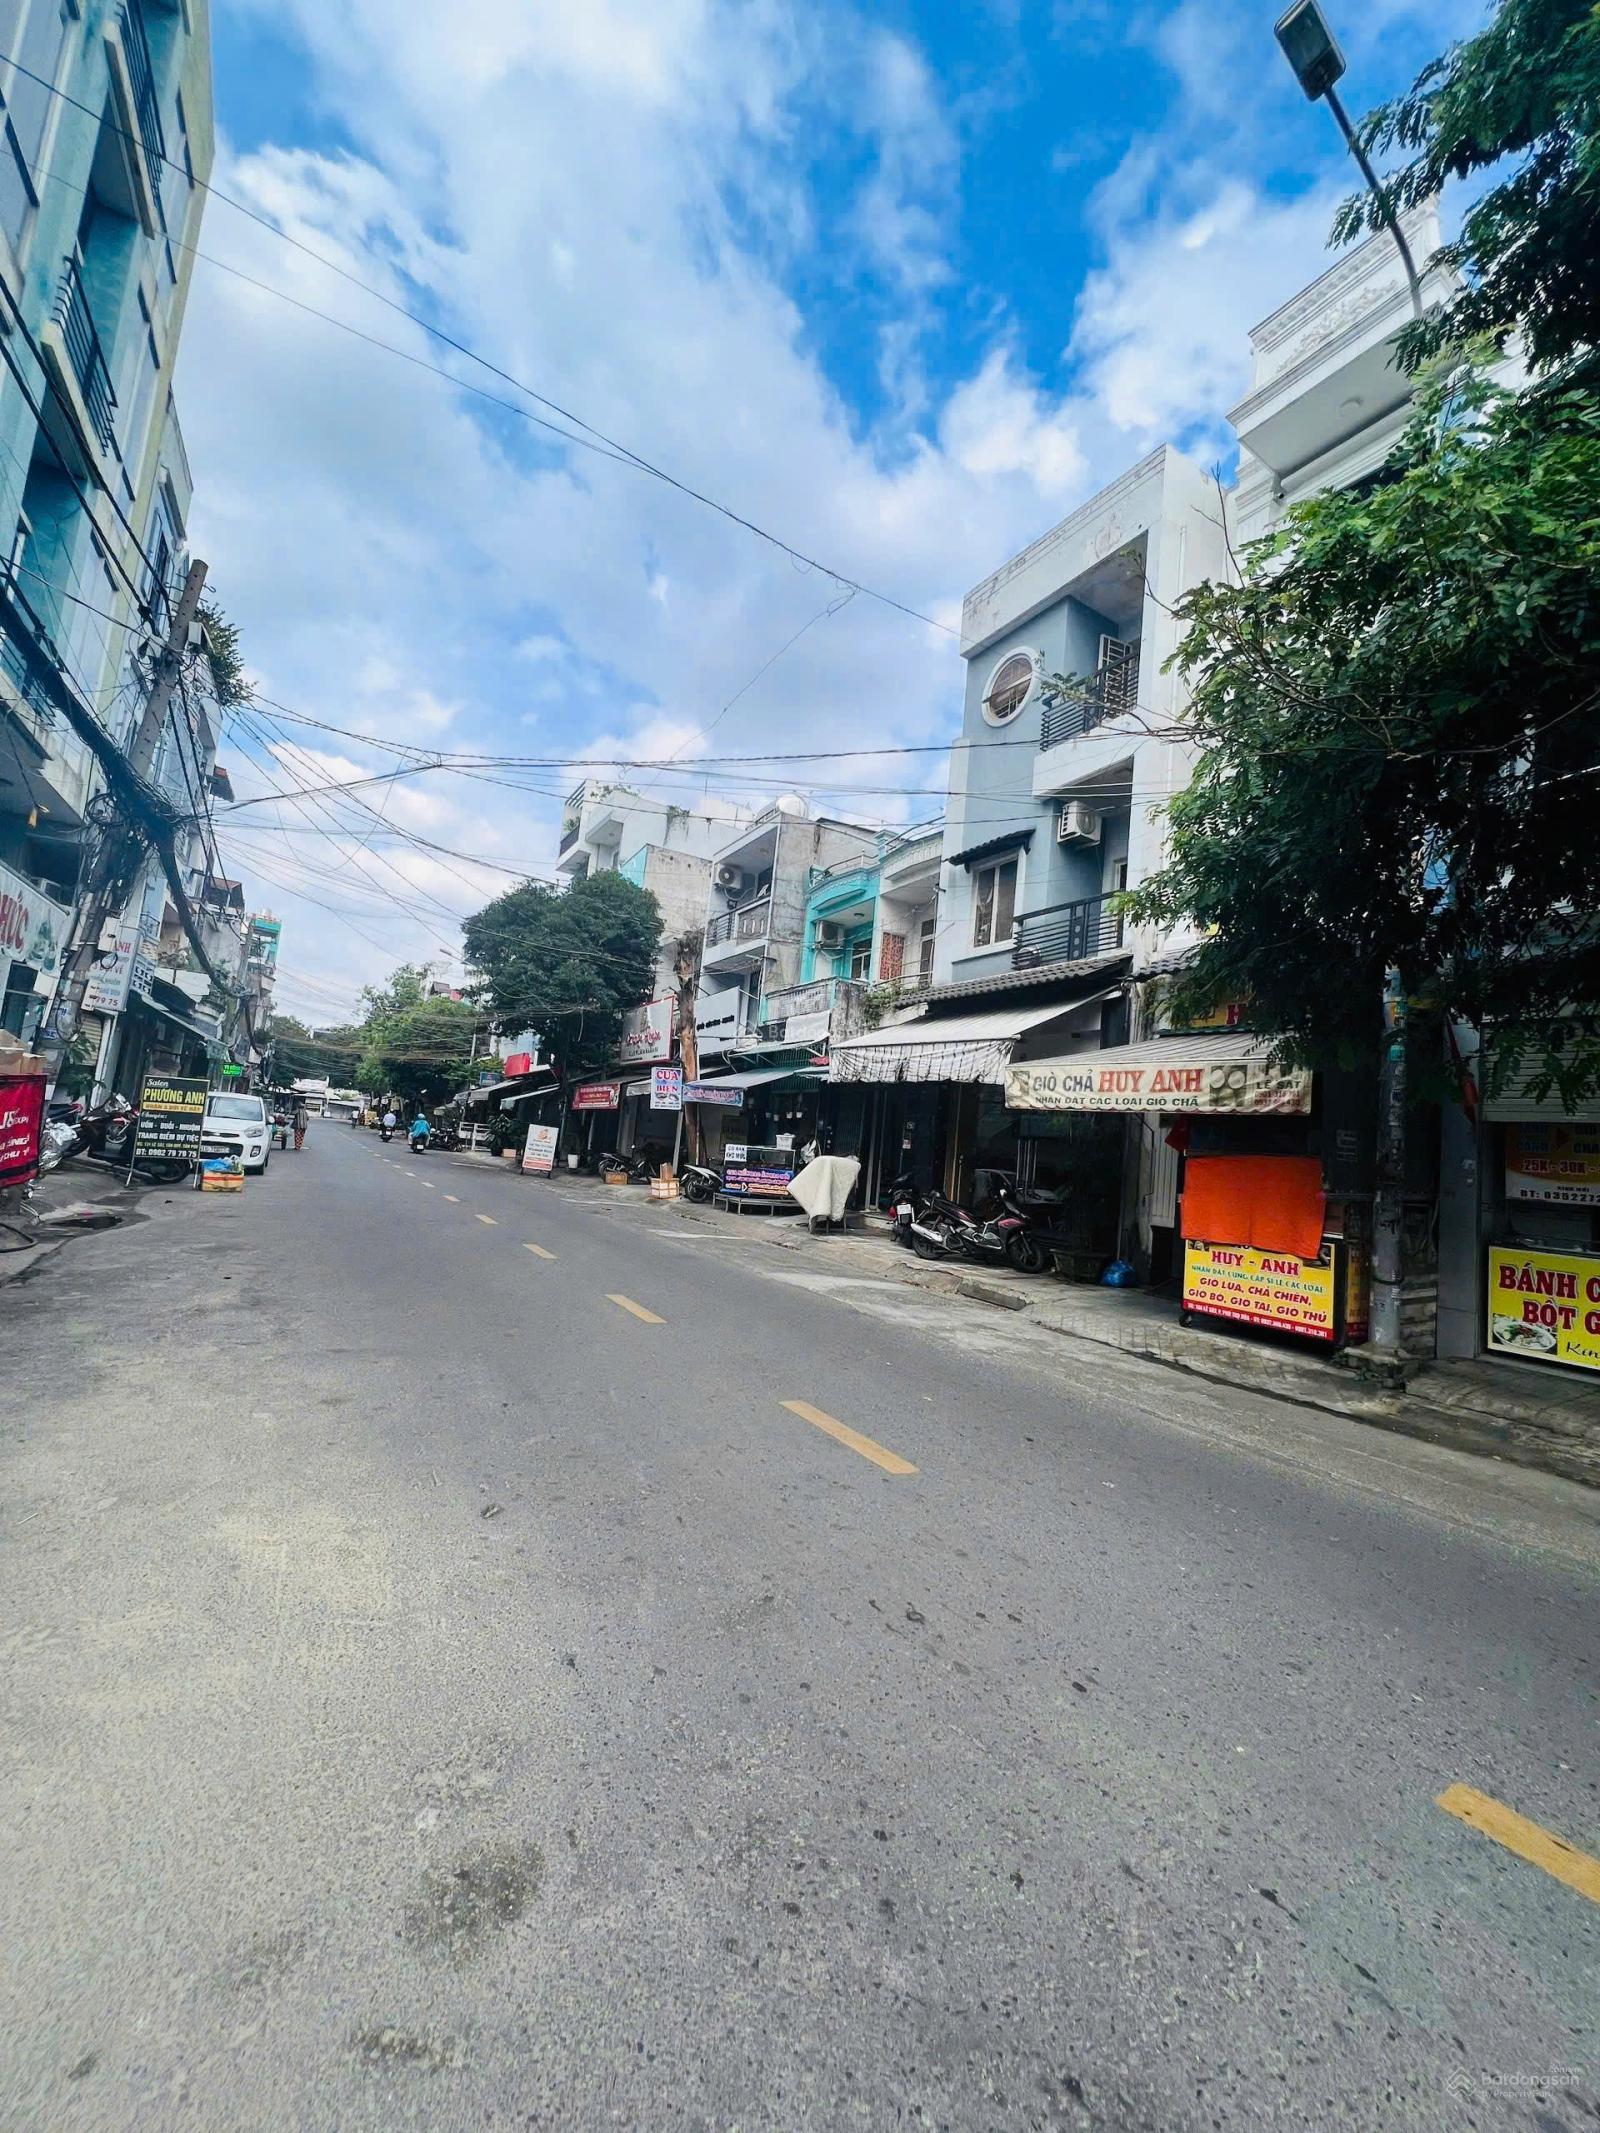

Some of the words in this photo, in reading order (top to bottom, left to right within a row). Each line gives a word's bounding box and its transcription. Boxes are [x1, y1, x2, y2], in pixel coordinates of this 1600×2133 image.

[656, 1070, 678, 1080] CUA
[1033, 1072, 1057, 1092] GIÒ
[1063, 1069, 1094, 1092] CHẢ
[1098, 1069, 1145, 1093] HUY
[1149, 1068, 1204, 1093] ANH
[143, 1088, 184, 1103] PHƯƠNG
[185, 1091, 206, 1105] ANH
[1171, 1096, 1200, 1107] CHẢ
[1211, 1250, 1244, 1267] HUY
[1260, 1258, 1300, 1276] ANH
[1499, 1261, 1578, 1300] BÁNH
